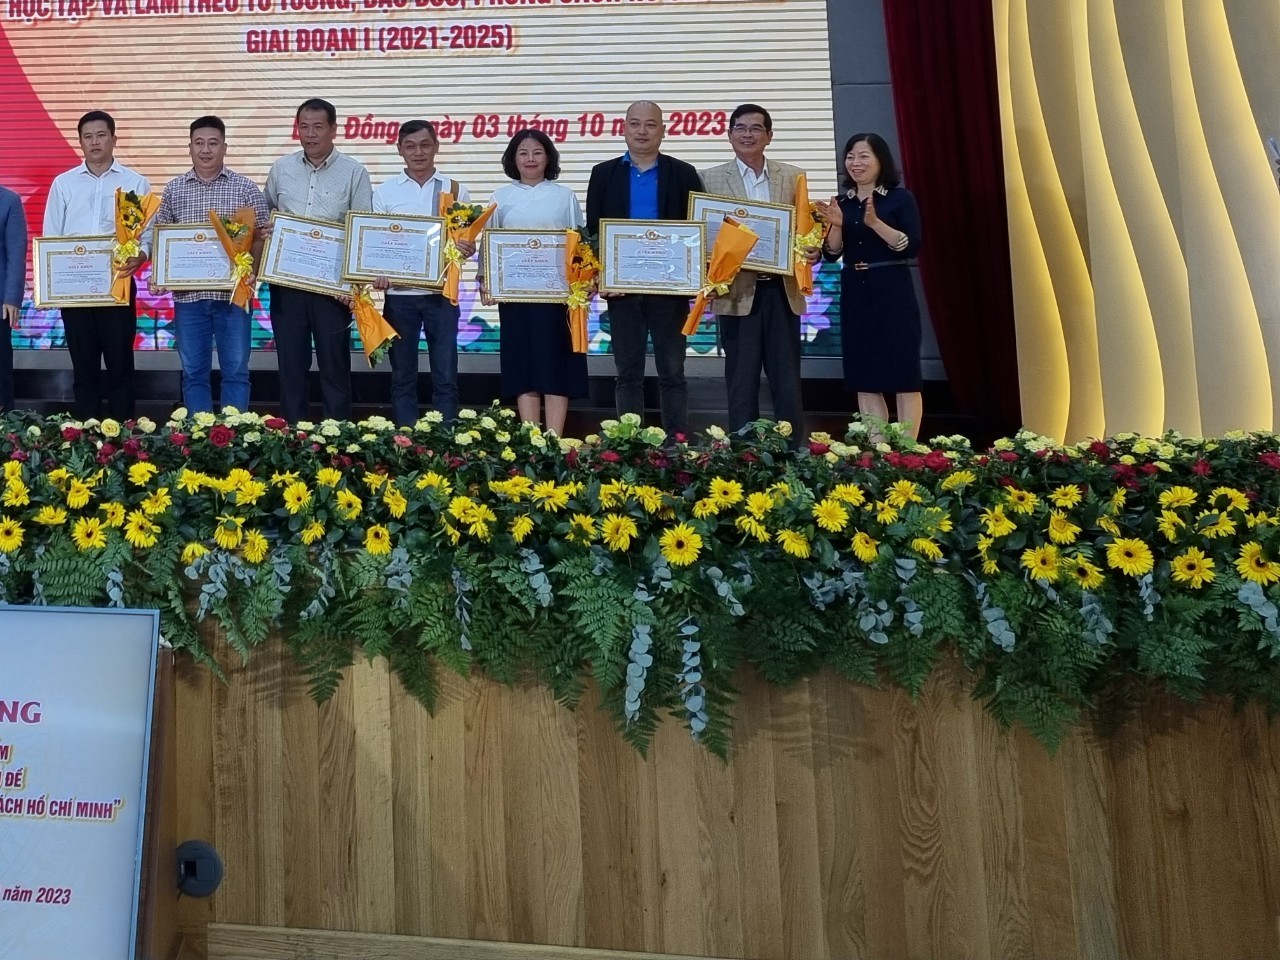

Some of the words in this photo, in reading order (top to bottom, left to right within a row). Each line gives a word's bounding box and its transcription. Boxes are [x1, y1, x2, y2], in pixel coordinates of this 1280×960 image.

[246, 28, 290, 54] GIAI
[295, 27, 357, 56] ĐOẠN
[363, 27, 371, 51] I
[378, 23, 513, 53] (2021-2025)
[472, 114, 500, 139] 03
[507, 113, 569, 143] tháng
[577, 112, 605, 137] 10
[668, 110, 727, 136] 2023
[5, 766, 23, 788] ĐỀ
[26, 794, 45, 815] HỒ
[49, 797, 73, 817] CHÍ
[2, 886, 33, 903] năm
[36, 887, 71, 905] 2023
